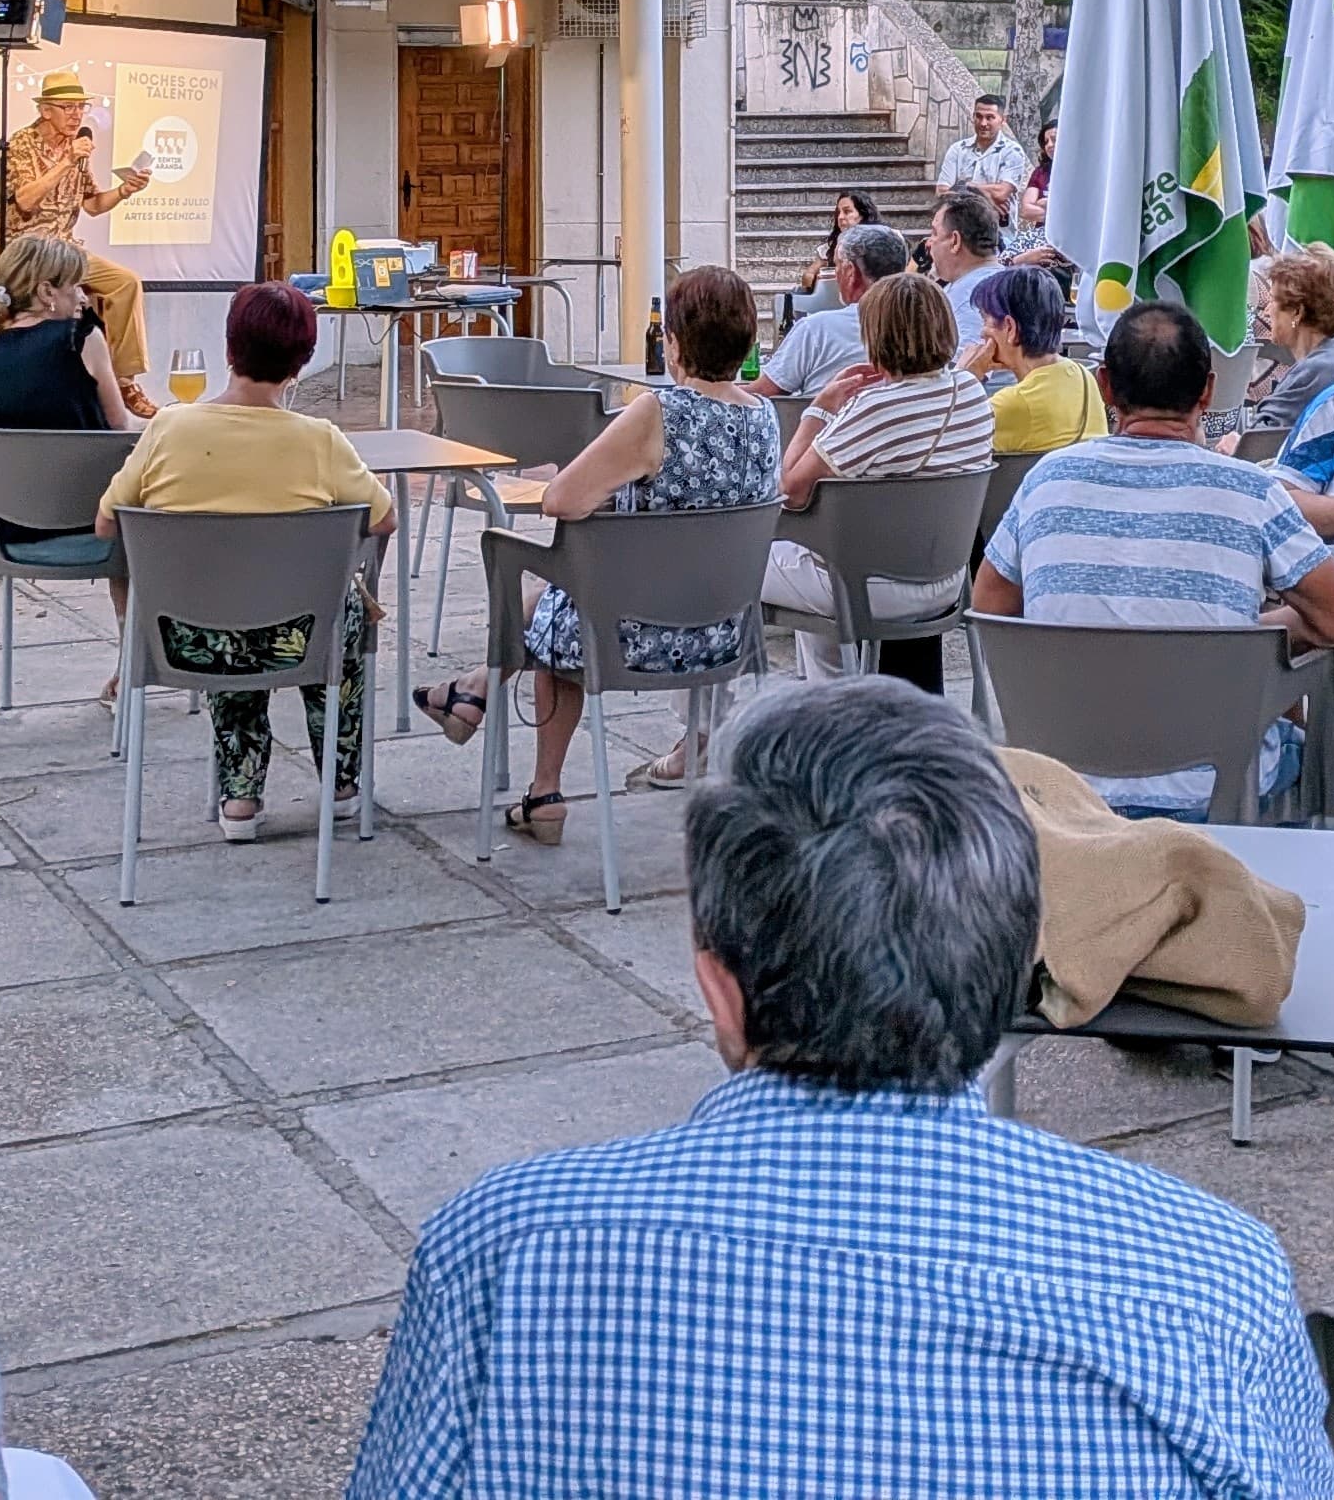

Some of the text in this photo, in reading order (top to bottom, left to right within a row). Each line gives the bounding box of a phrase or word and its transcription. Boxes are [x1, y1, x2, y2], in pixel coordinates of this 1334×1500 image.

[128, 72, 219, 90] NOCHES CON
[146, 86, 204, 101] TALENTO
[123, 198, 210, 207] JUEVES 3 DE JULIO
[124, 213, 154, 221] ARTES
